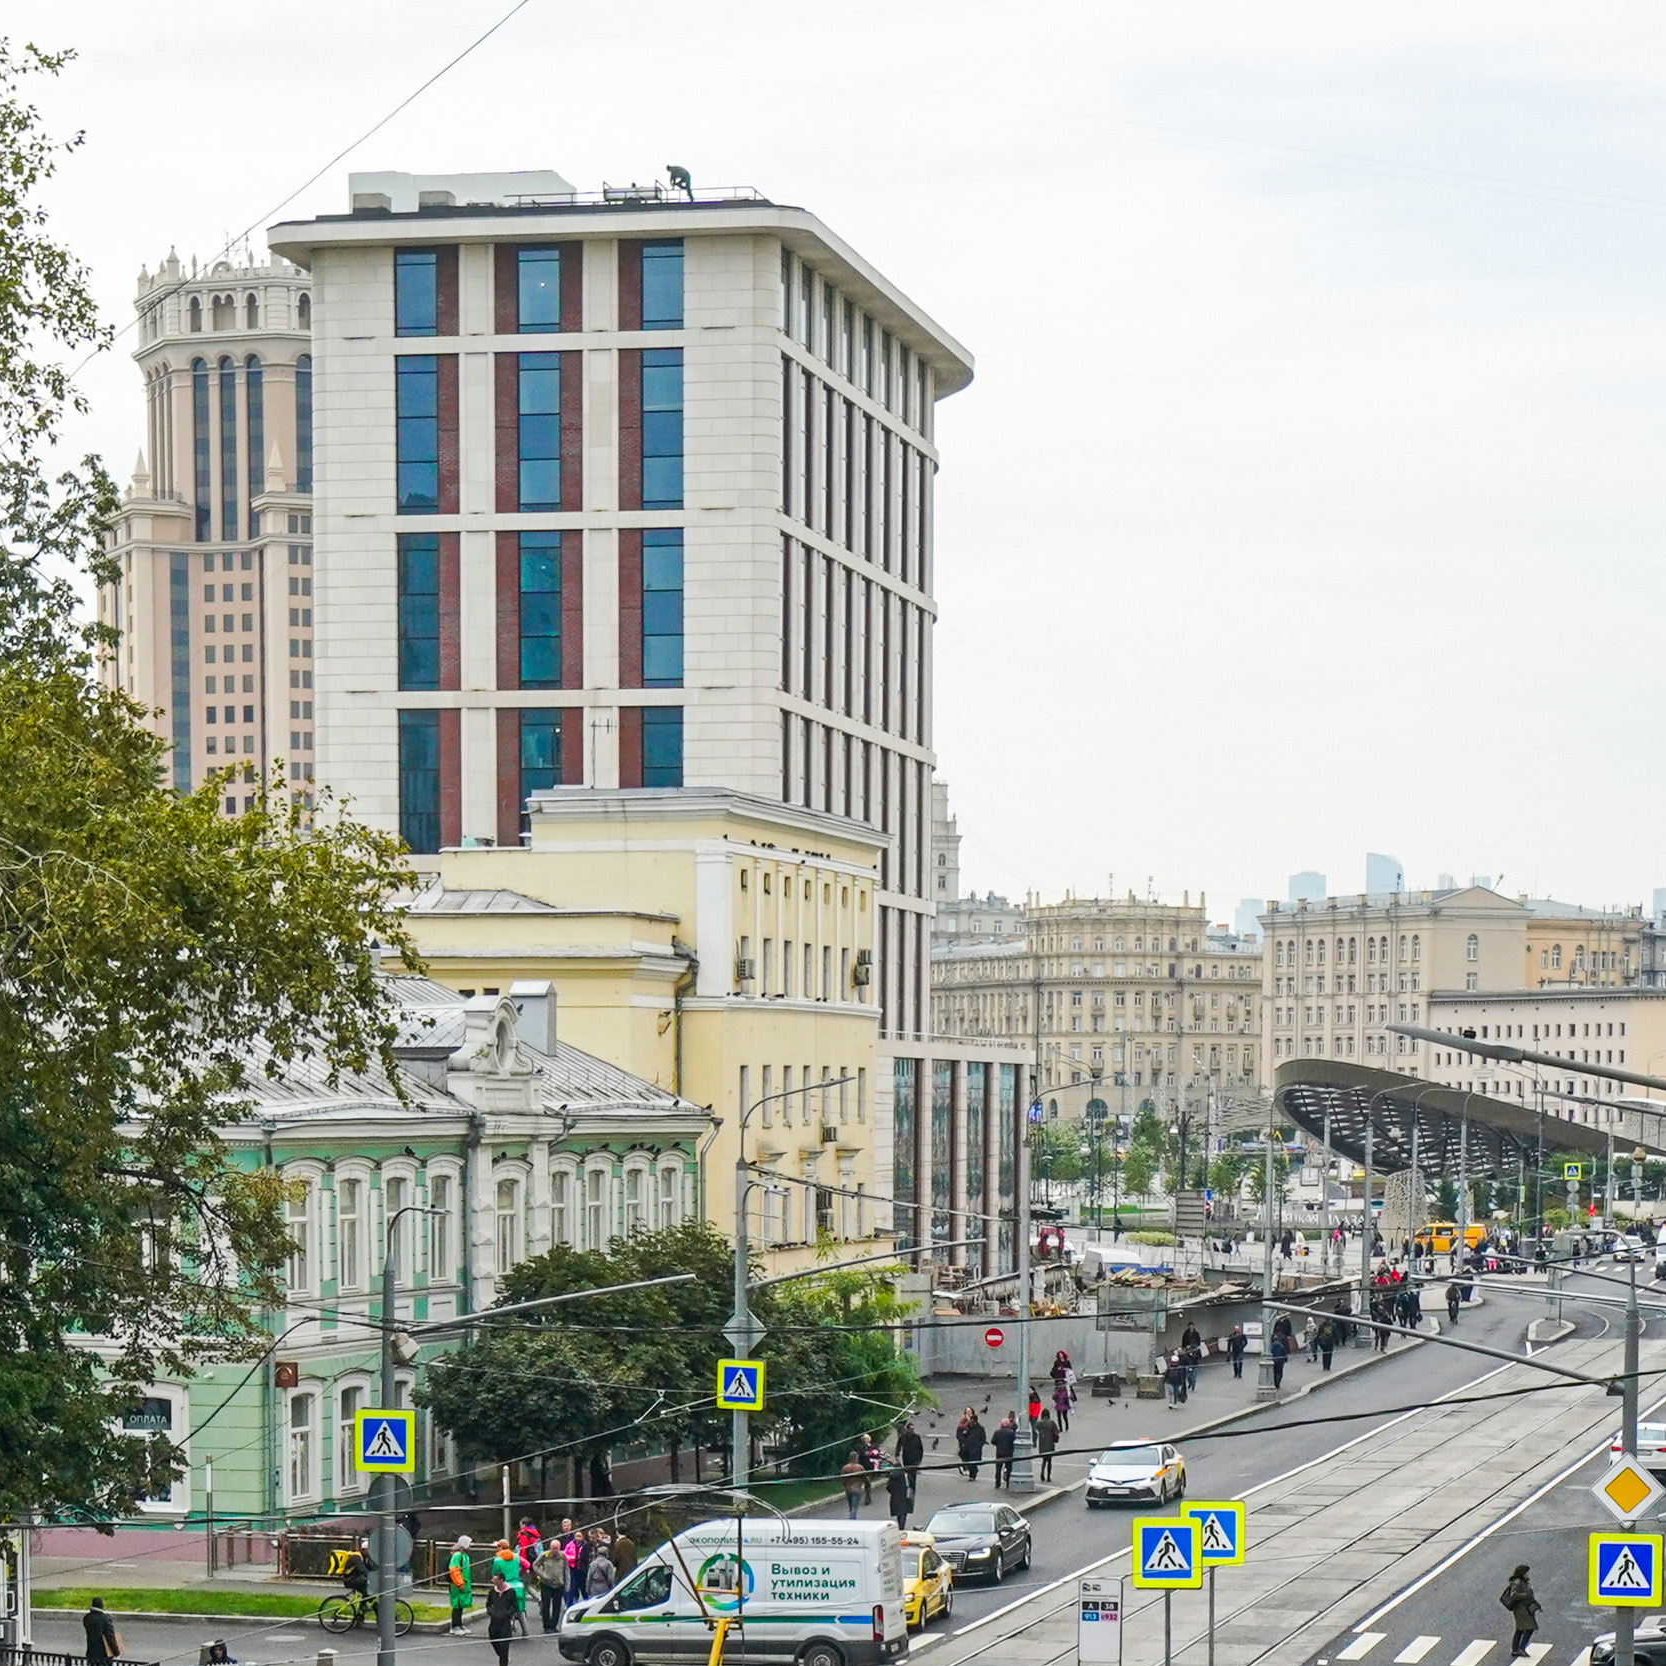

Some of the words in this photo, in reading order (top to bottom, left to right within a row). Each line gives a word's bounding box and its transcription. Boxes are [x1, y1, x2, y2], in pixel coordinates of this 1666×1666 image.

[129, 1415, 168, 1424] ОПЛАТА
[811, 1537, 859, 1545] 155-55-24
[771, 1564, 818, 1575] Вывоз
[822, 1567, 830, 1575] и
[771, 1578, 856, 1590] утилизация
[771, 1592, 830, 1600] техники
